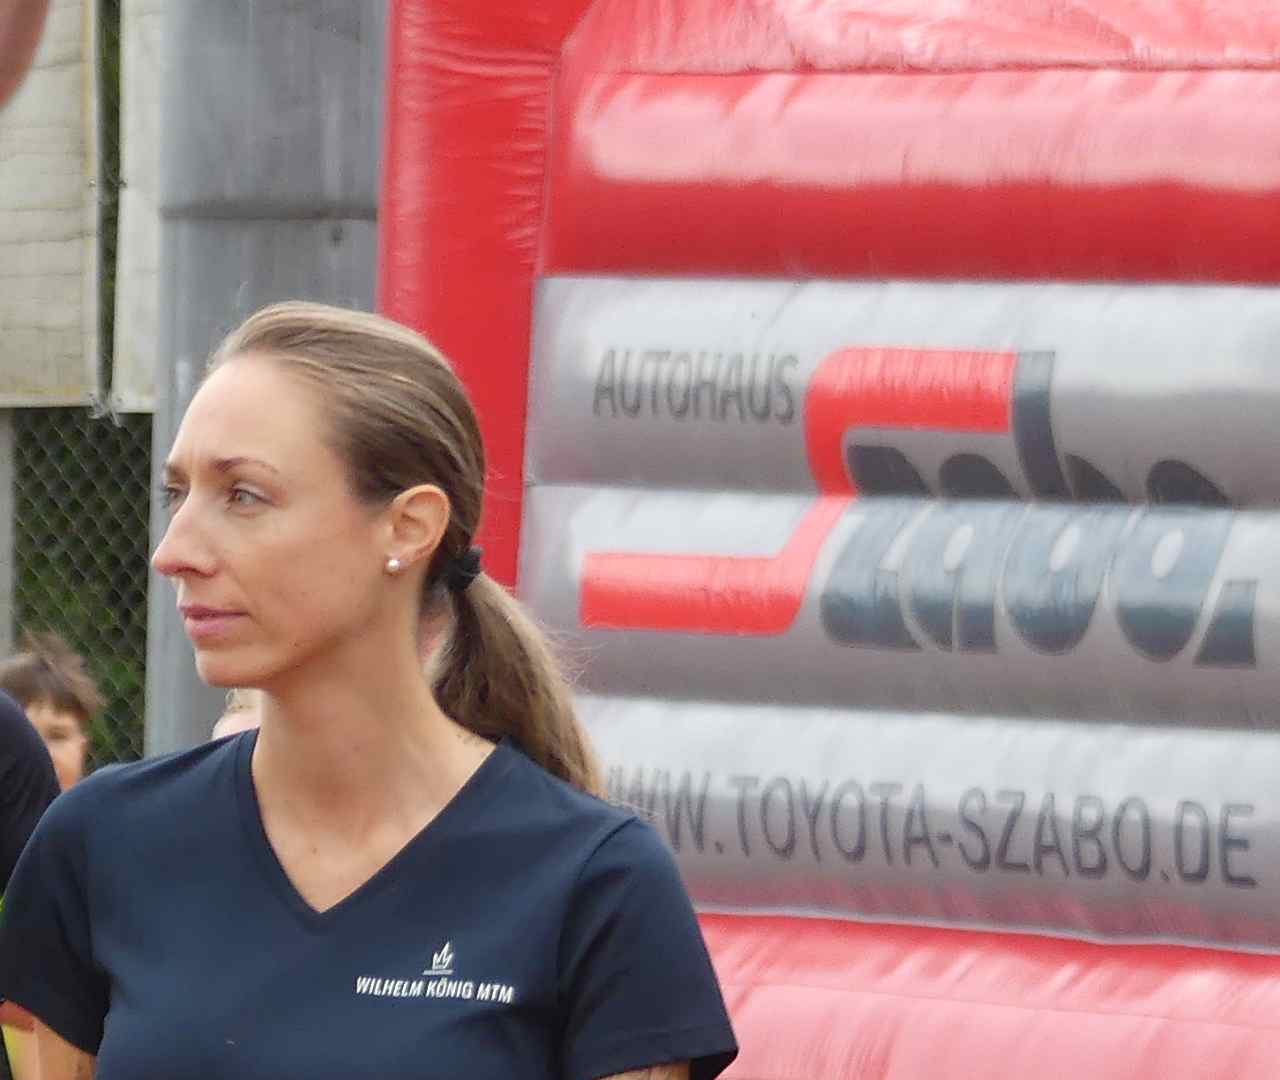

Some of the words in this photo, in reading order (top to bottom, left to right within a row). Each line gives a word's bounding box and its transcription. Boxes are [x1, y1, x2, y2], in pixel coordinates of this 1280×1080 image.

[592, 348, 800, 425] AUTOHAUS
[608, 765, 1258, 888] WW.TOYOTA-SZABO.DE
[355, 975, 424, 998] WILHELM
[425, 977, 474, 999] KÖNIG
[476, 983, 515, 1004] MTM
